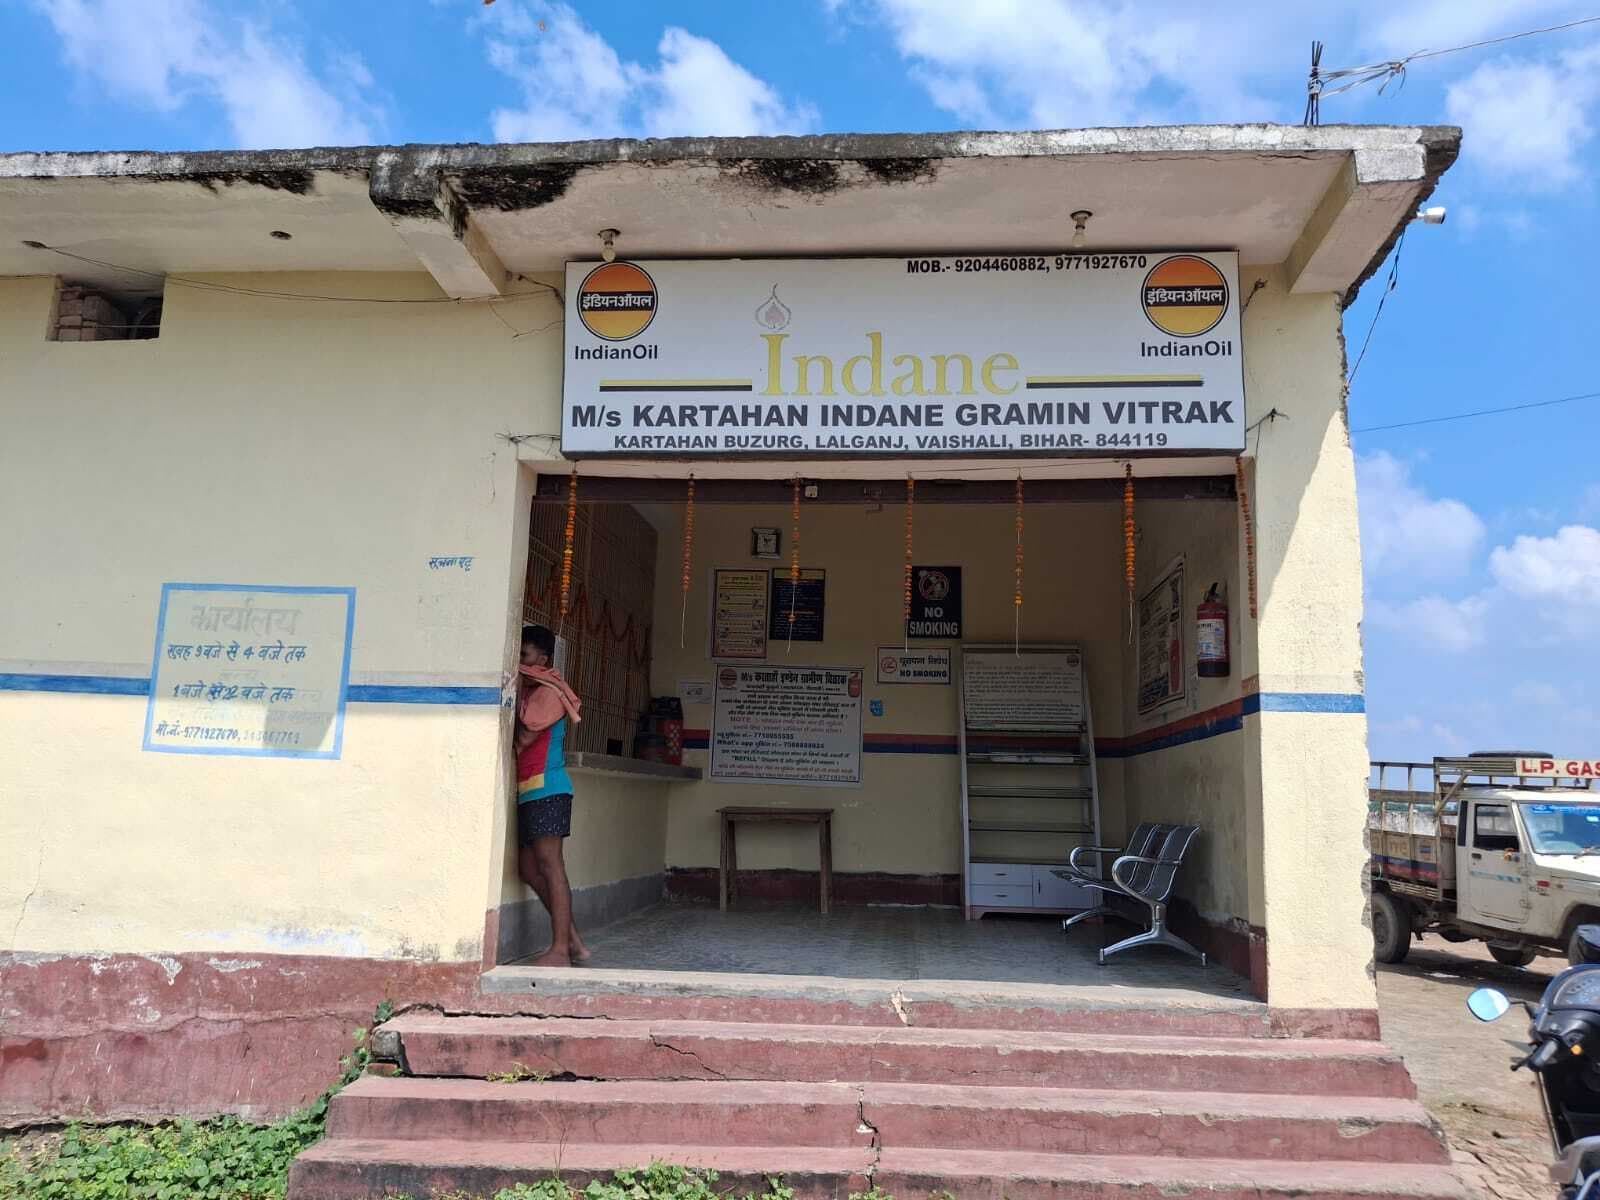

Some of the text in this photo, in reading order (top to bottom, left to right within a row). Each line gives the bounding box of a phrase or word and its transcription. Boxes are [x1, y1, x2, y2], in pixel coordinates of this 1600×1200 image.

[907, 255, 1147, 274] MOB.- 9204460882, 9771927670
[582, 292, 653, 309] इंडियनऑयल
[1146, 287, 1223, 304] इंडियनऑयल
[574, 344, 659, 361] IndianOil
[1141, 340, 1233, 358] IndianOil
[758, 331, 1020, 397] Indane
[571, 400, 1235, 428] M/s KARTAHAN INDANE GRAMIN VITRAK
[614, 432, 1168, 451] KARTAHAN BUZURG, LALGANJ, VAISHALI, BIHAR- 844119
[191, 597, 302, 637] कार्यालय
[924, 607, 944, 618] NO
[909, 621, 958, 636] SMOKING
[243, 645, 255, 661] 4
[285, 645, 308, 664] तक
[270, 687, 296, 704] तक
[1522, 760, 1560, 774] L.P.
